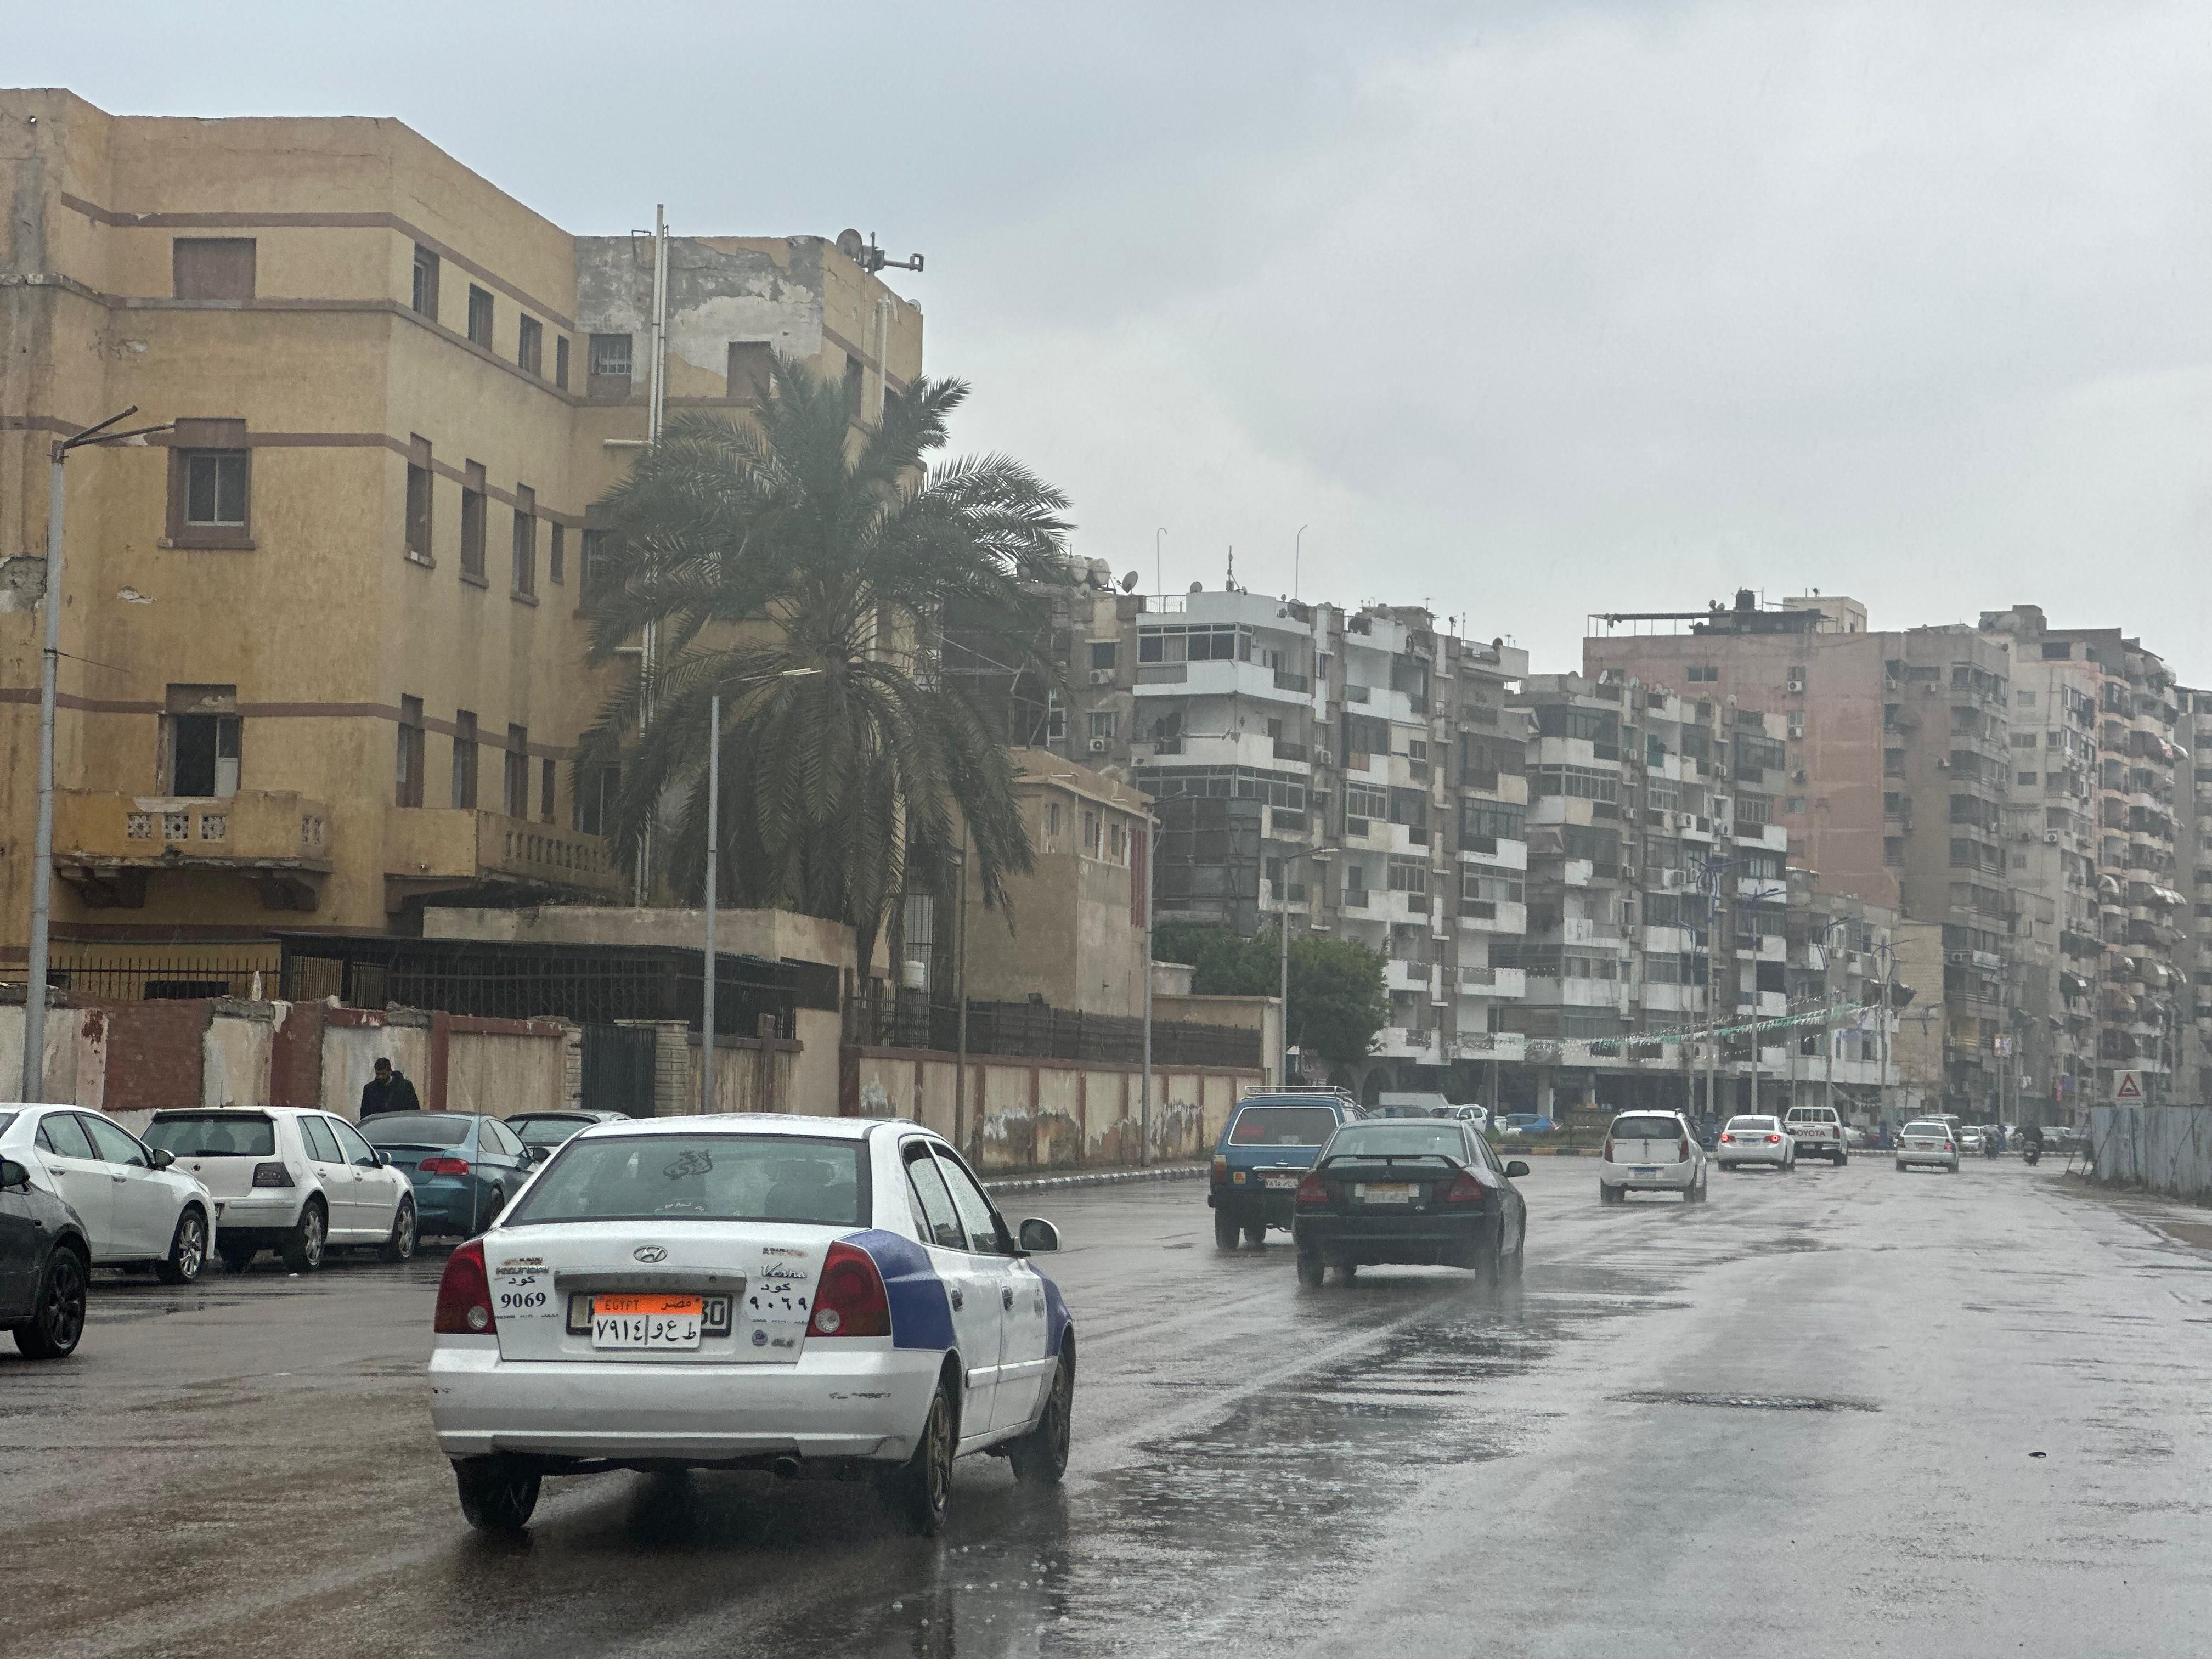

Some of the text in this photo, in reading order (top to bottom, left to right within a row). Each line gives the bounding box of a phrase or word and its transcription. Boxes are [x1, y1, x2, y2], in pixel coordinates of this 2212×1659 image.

[761, 1262, 808, 1279] Verna
[507, 1276, 535, 1286] كود
[761, 1283, 791, 1293] كود
[500, 1291, 546, 1308] 9069
[605, 1300, 640, 1310] EGYPT
[660, 1300, 692, 1310] مصر
[749, 1296, 808, 1311] ٩٠٦٩
[596, 1319, 643, 1341] ٧٩١٤
